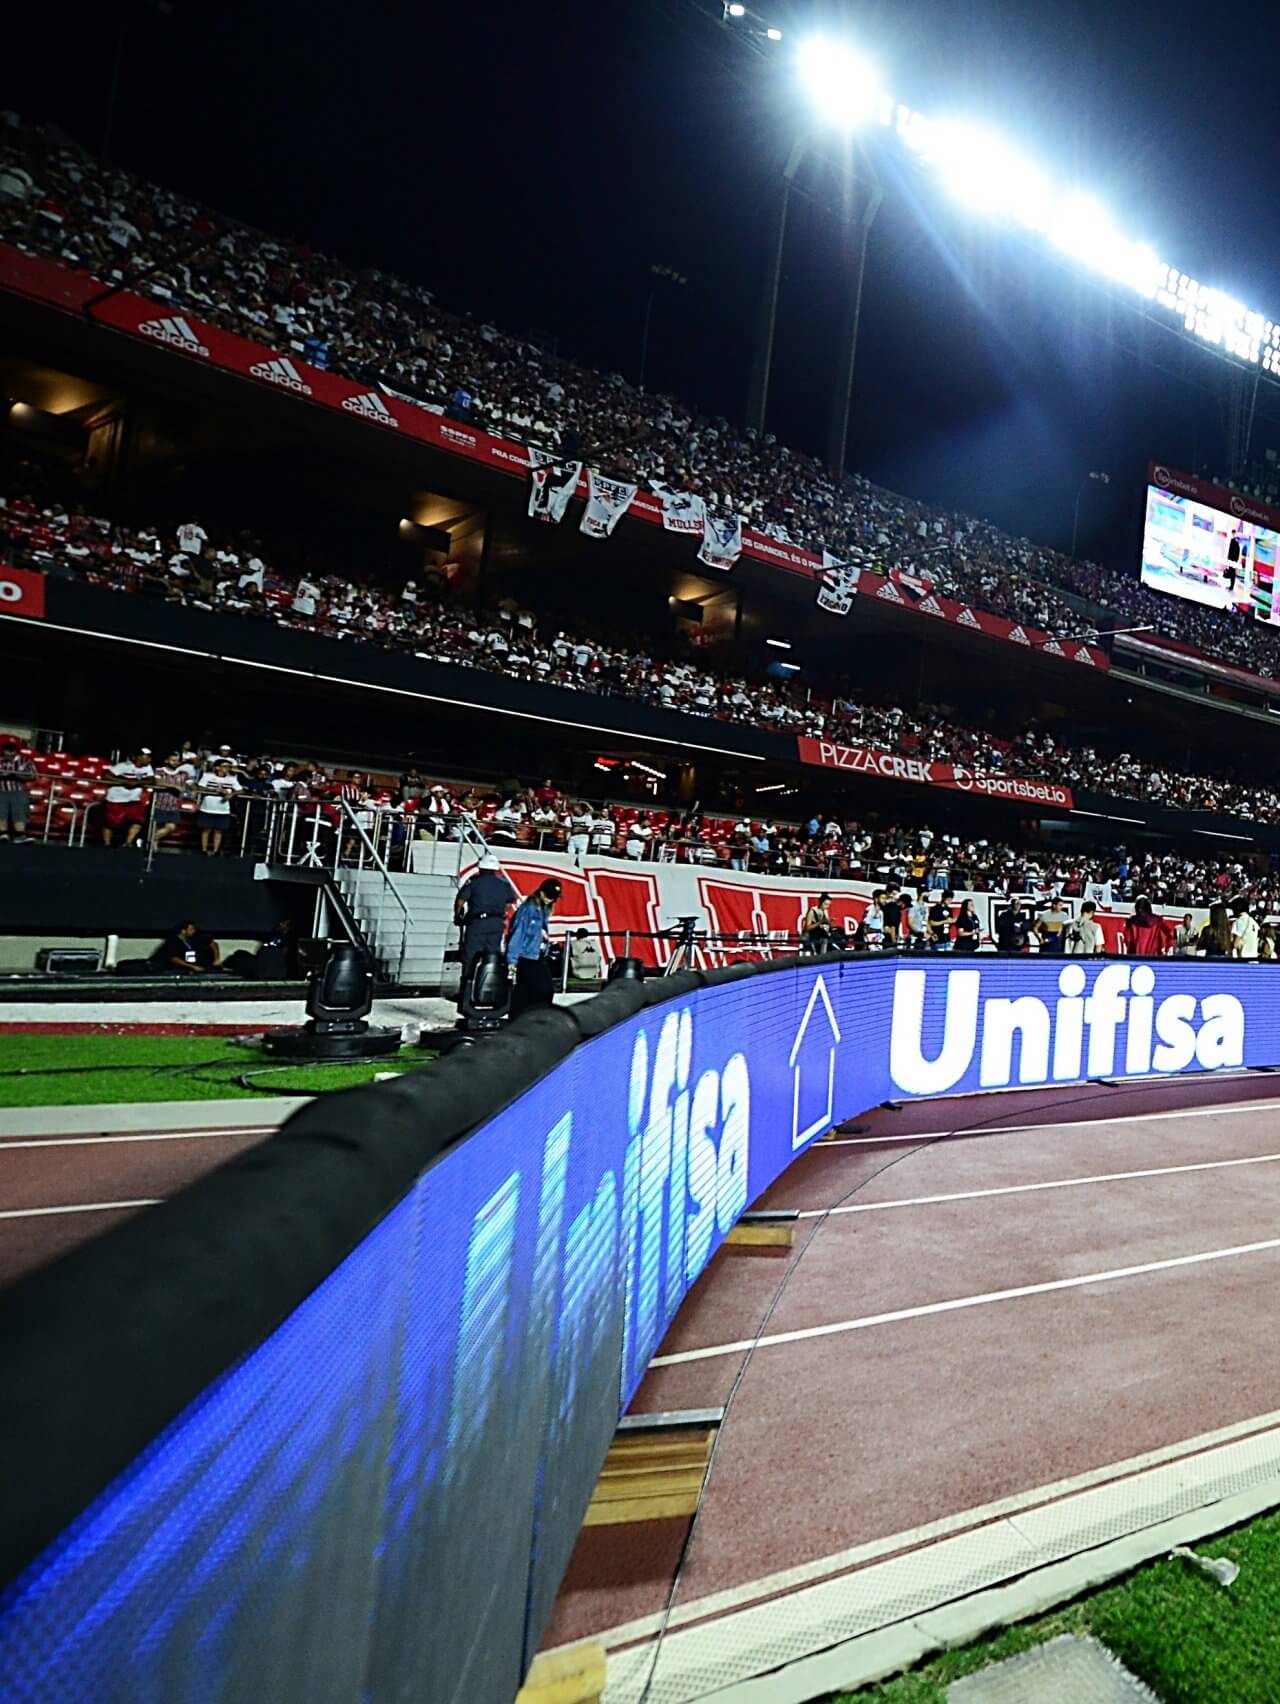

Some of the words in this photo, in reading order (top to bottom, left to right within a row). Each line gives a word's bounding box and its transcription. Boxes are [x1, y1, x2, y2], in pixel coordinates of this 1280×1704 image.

[138, 322, 210, 357] adidas
[249, 364, 313, 395] adidas
[341, 400, 399, 427] adidas
[819, 742, 934, 782] PIZZACREK
[975, 772, 1067, 803] Sportsbet.io
[890, 964, 1244, 1095] Unifisa
